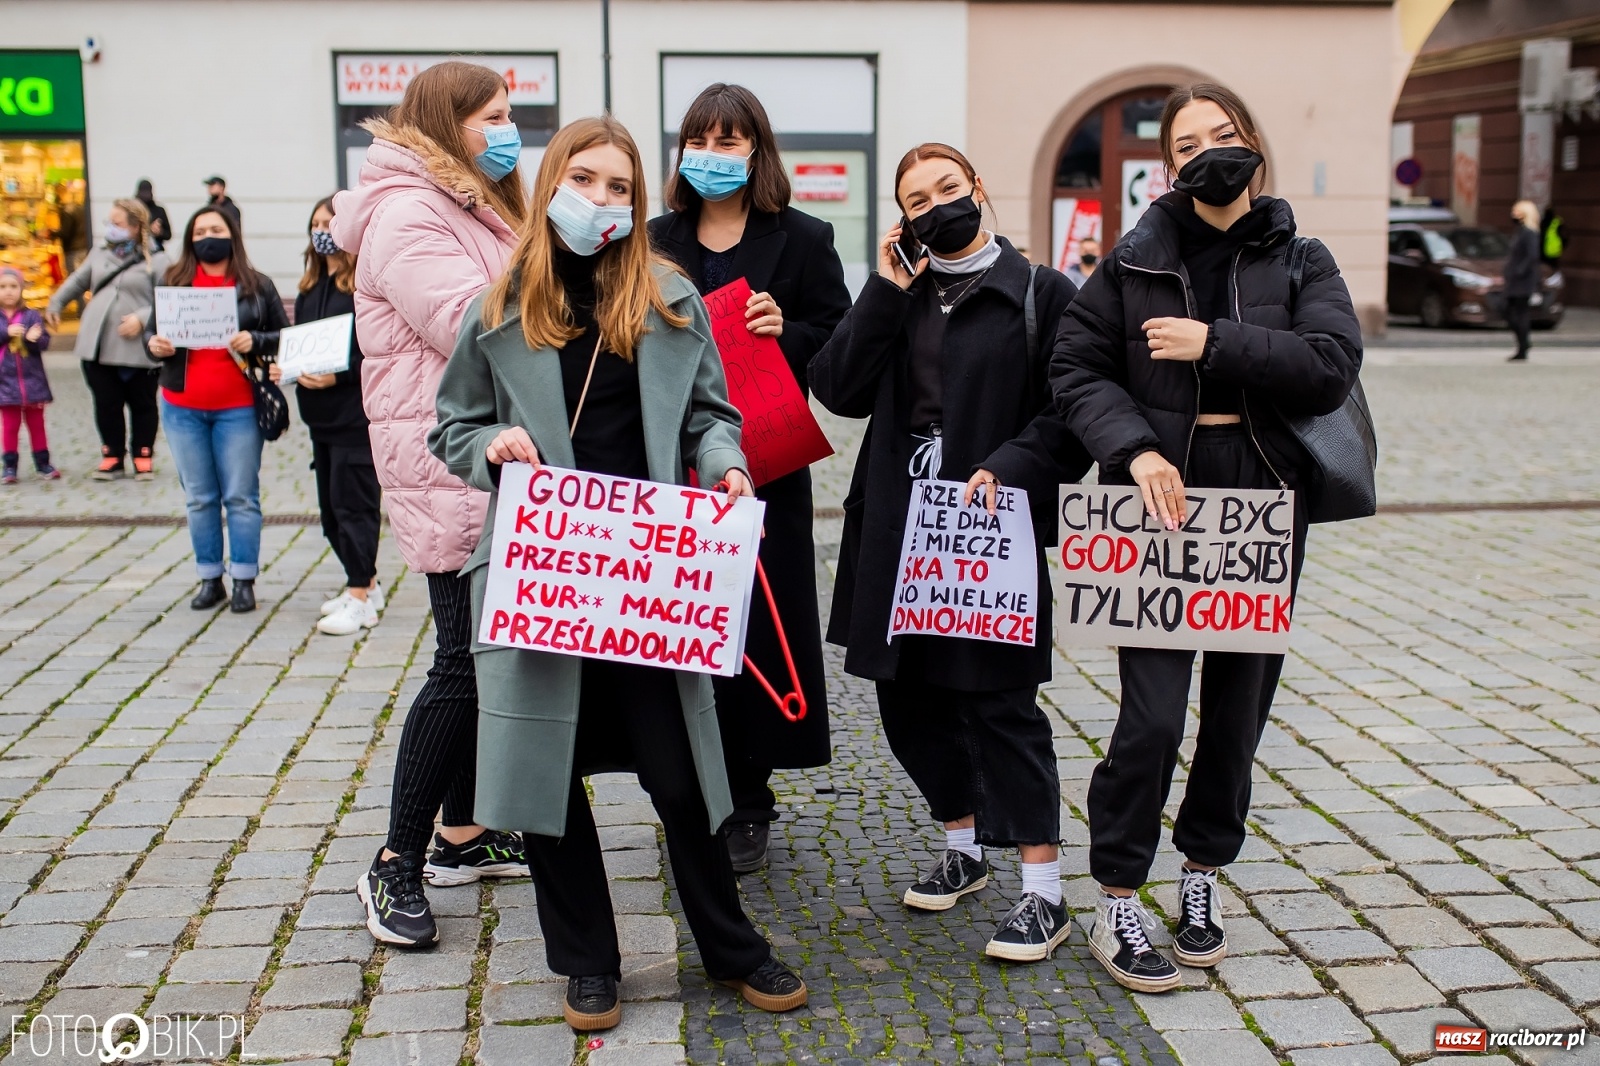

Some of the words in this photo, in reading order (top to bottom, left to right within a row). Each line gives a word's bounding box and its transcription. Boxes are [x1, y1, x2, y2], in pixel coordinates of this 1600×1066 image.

[726, 349, 784, 411] PIS
[741, 401, 807, 453] ERACJĘ!
[528, 469, 658, 516] GODEK
[680, 490, 734, 525] TY
[919, 481, 958, 509] RZE
[1062, 493, 1206, 533] CHCEZ
[1219, 490, 1291, 536] BYĆ
[915, 509, 948, 531] LE
[957, 511, 1002, 534] DWA
[925, 532, 1012, 560] MIECZE
[505, 541, 653, 584] PRZESTAŃ
[674, 566, 713, 593] MI
[954, 558, 989, 583] TO
[1062, 533, 1139, 574] GOD
[1139, 536, 1201, 583] ALE
[1203, 532, 1291, 586] JESTEŚ
[930, 586, 1028, 613] WIELKIE
[1065, 582, 1184, 633] TYLKO
[1186, 590, 1291, 634] GODEK
[489, 609, 729, 670] PRZEŚLADOWAĆ
[892, 607, 1035, 644] DNIOWIECZE
